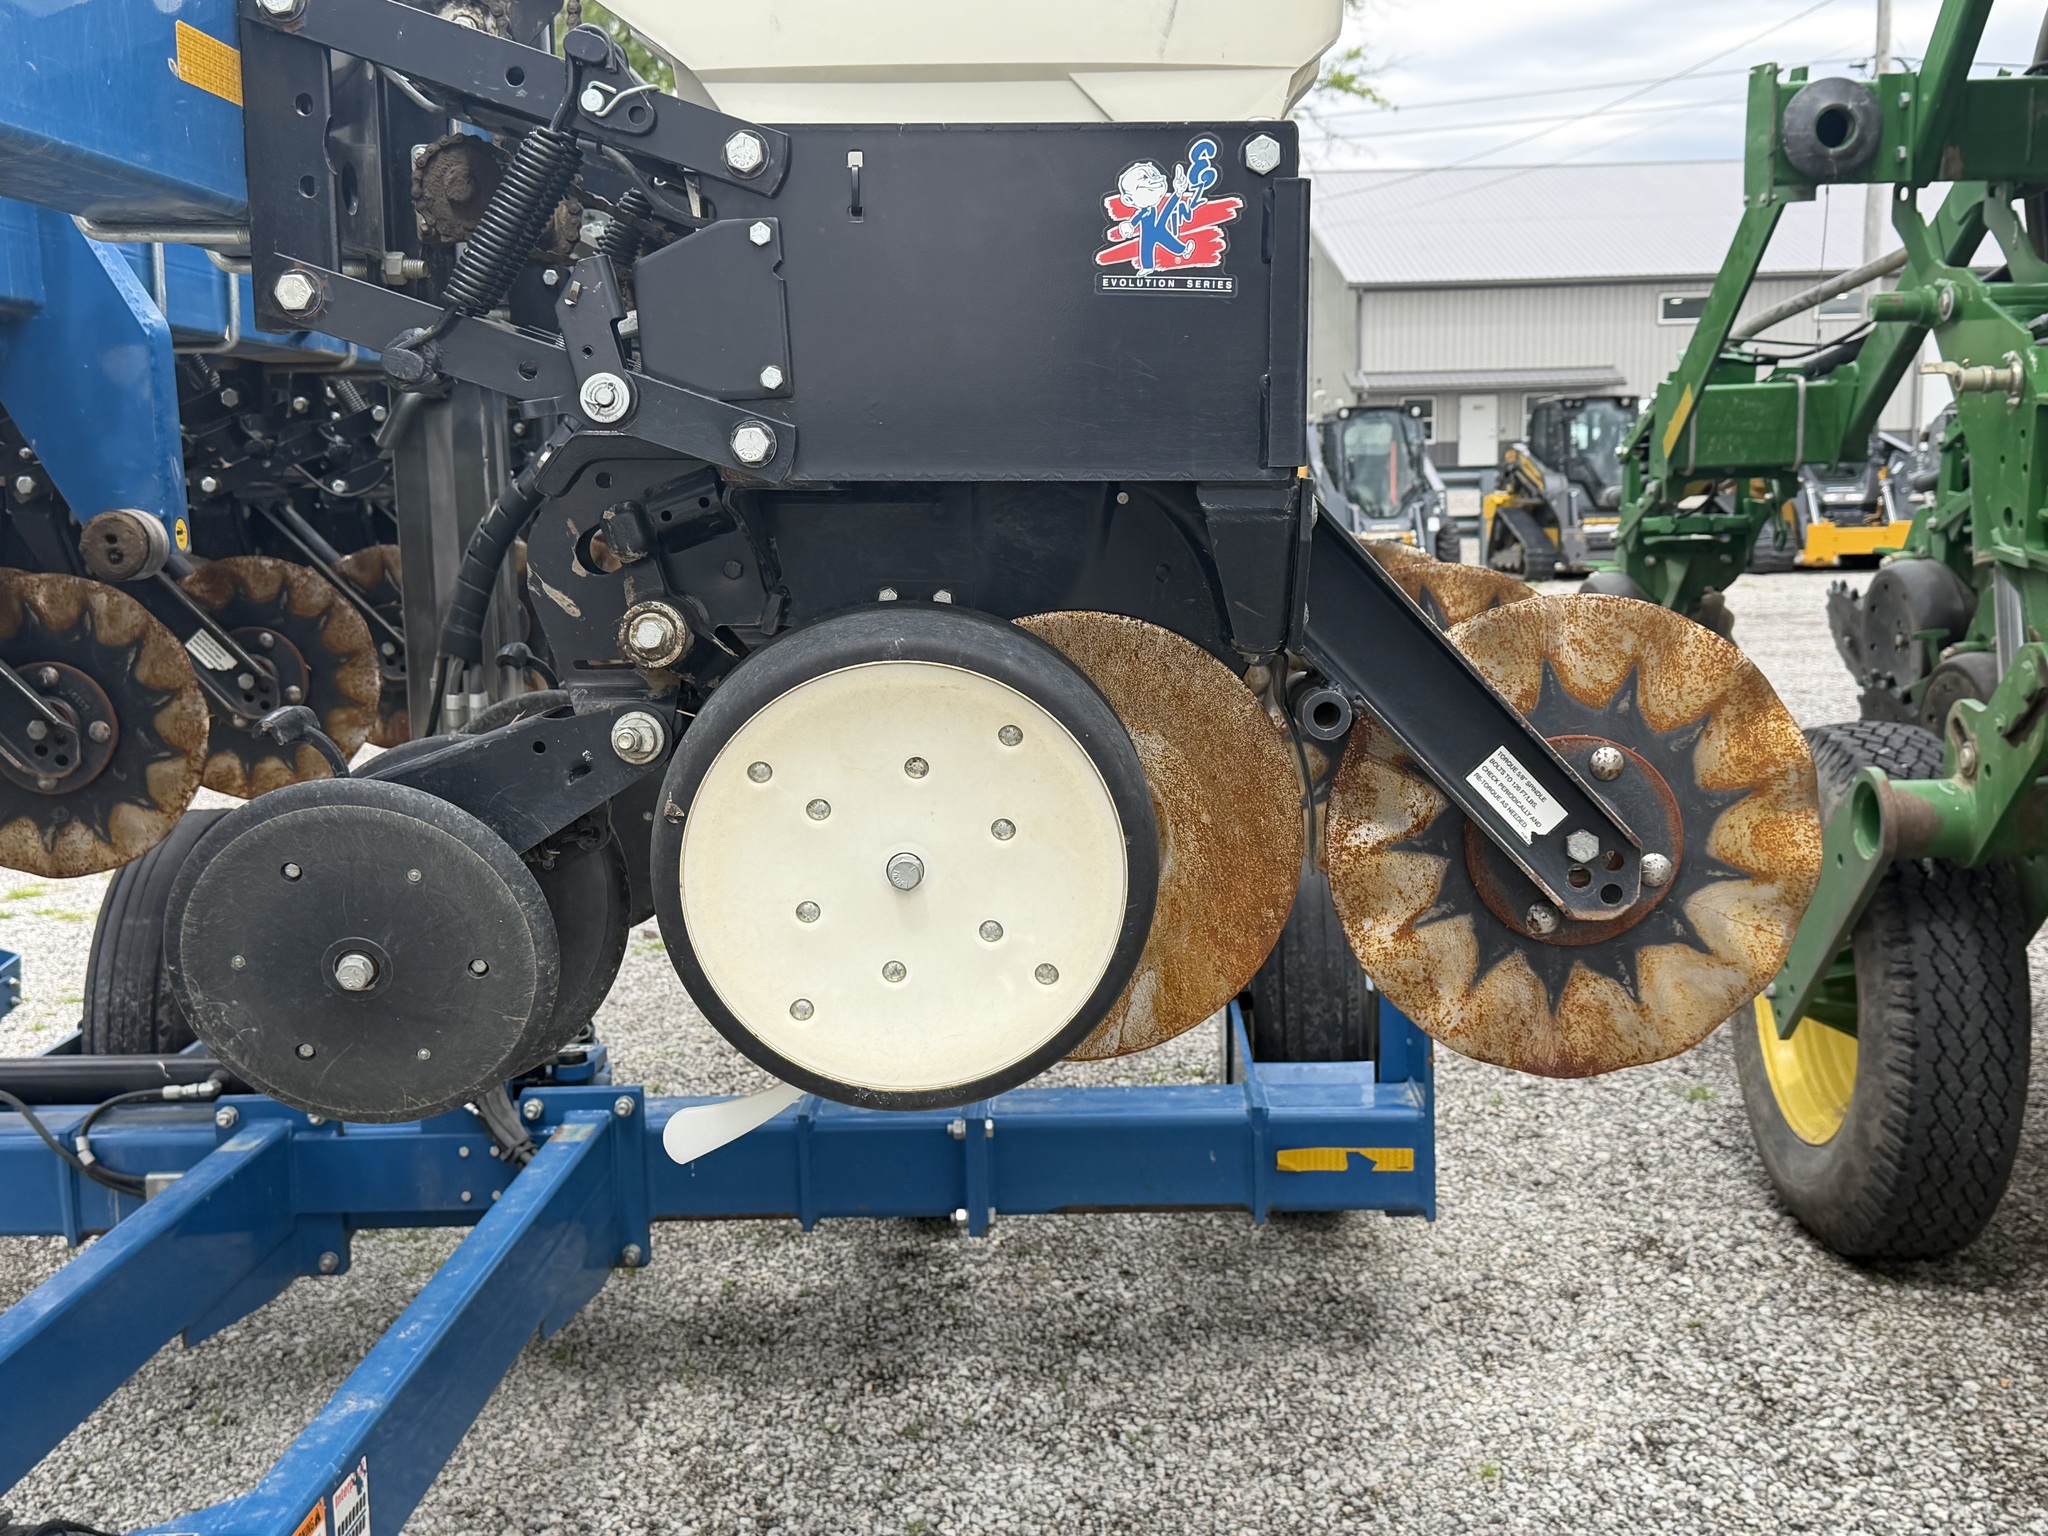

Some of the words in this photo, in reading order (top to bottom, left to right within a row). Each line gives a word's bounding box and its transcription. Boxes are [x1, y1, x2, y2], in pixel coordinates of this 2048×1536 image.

[1102, 278, 1175, 288] EVOLUTION
[1186, 279, 1233, 289] SERIES
[1473, 772, 1502, 801] RE-TORQUE
[1489, 758, 1507, 777] BOLTS
[1512, 782, 1521, 792] 120
[1497, 751, 1518, 773] TORQUE
[1525, 781, 1547, 803] SPINDLE
[1481, 765, 1500, 784] CHECK
[1497, 782, 1532, 816] PERIODICALLY
[1530, 815, 1542, 828] AND
